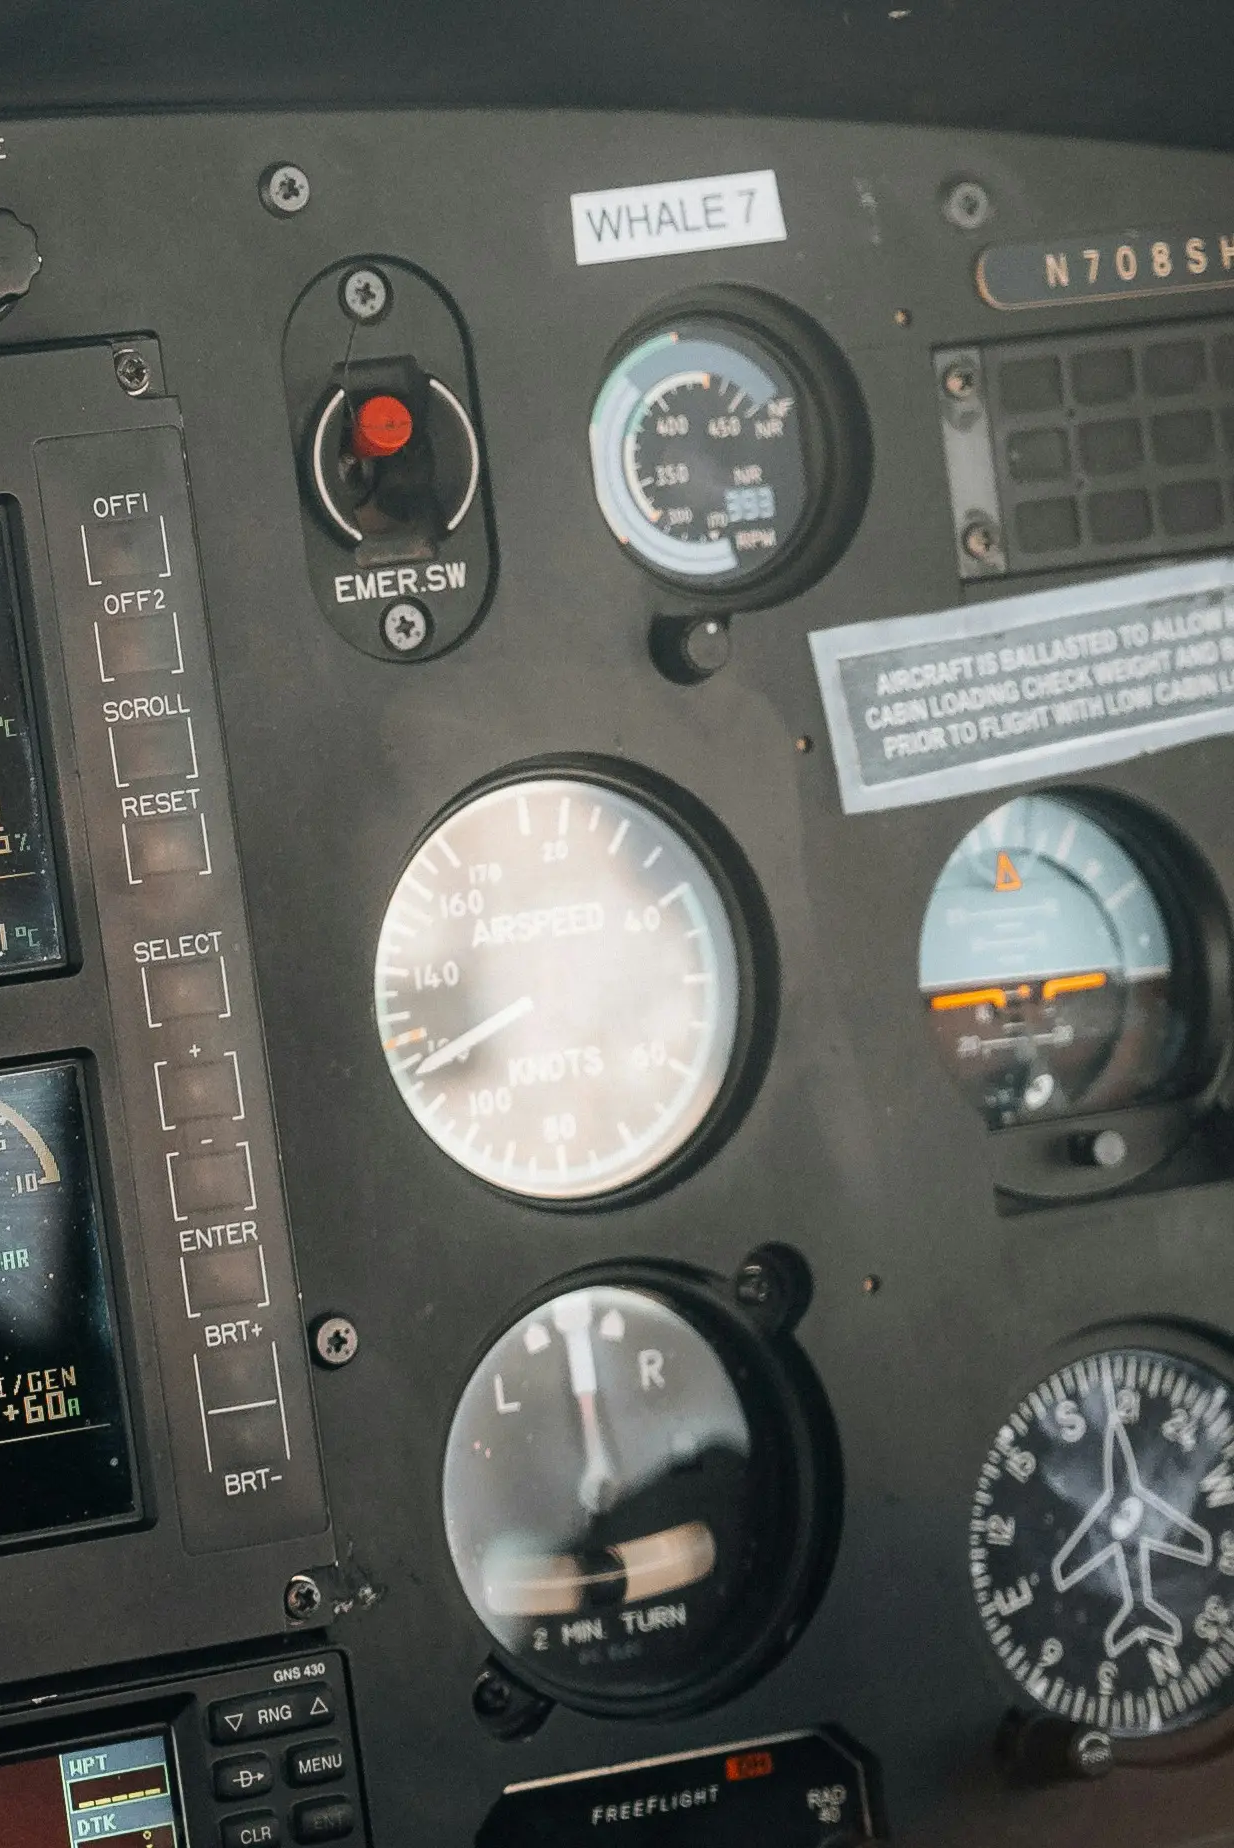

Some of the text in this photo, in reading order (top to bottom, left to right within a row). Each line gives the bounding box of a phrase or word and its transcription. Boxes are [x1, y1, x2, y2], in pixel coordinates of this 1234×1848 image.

[586, 188, 759, 244] WHALE 7
[93, 492, 150, 519] OFF1
[103, 589, 166, 616] OFF2
[876, 658, 976, 697] AIRCRAFT
[976, 653, 1000, 677] IS
[999, 627, 1118, 672] BALLASTED
[1118, 621, 1150, 649] TO
[1150, 608, 1224, 641] ALLOW
[865, 699, 929, 732] CABIN
[929, 678, 1021, 720] LOADING
[1022, 666, 1095, 701] CHECK
[1090, 648, 1172, 687] WEIGHT
[103, 694, 191, 723] SCROLL
[882, 723, 949, 760] PRIOR
[949, 720, 979, 748] TO
[978, 704, 1051, 742] FLIGHT
[1154, 670, 1219, 706] CABIN
[121, 789, 201, 818] RESET
[440, 891, 484, 919] 160
[472, 903, 605, 948] AIRSPEED
[133, 931, 223, 963] SELECT
[413, 962, 459, 991] 140
[508, 1045, 604, 1087] KNOTS
[469, 1087, 512, 1117] 100
[14, 1172, 39, 1195] 10
[178, 1221, 259, 1253] ENTER
[204, 1320, 264, 1348] BRT+
[638, 1348, 666, 1391] R
[494, 1374, 521, 1415] L
[1055, 1400, 1087, 1442] S
[224, 1469, 284, 1496] BRT-
[994, 1576, 1034, 1617] E
[533, 1627, 549, 1652] 2
[621, 1603, 687, 1635] TURN
[273, 1662, 326, 1683] GNS 430
[257, 1704, 293, 1725] RNG
[298, 1753, 343, 1774] MENU
[592, 1783, 720, 1826] FREEFLIGHT
[77, 1814, 117, 1837] DTK
[240, 1827, 272, 1846] CLR
